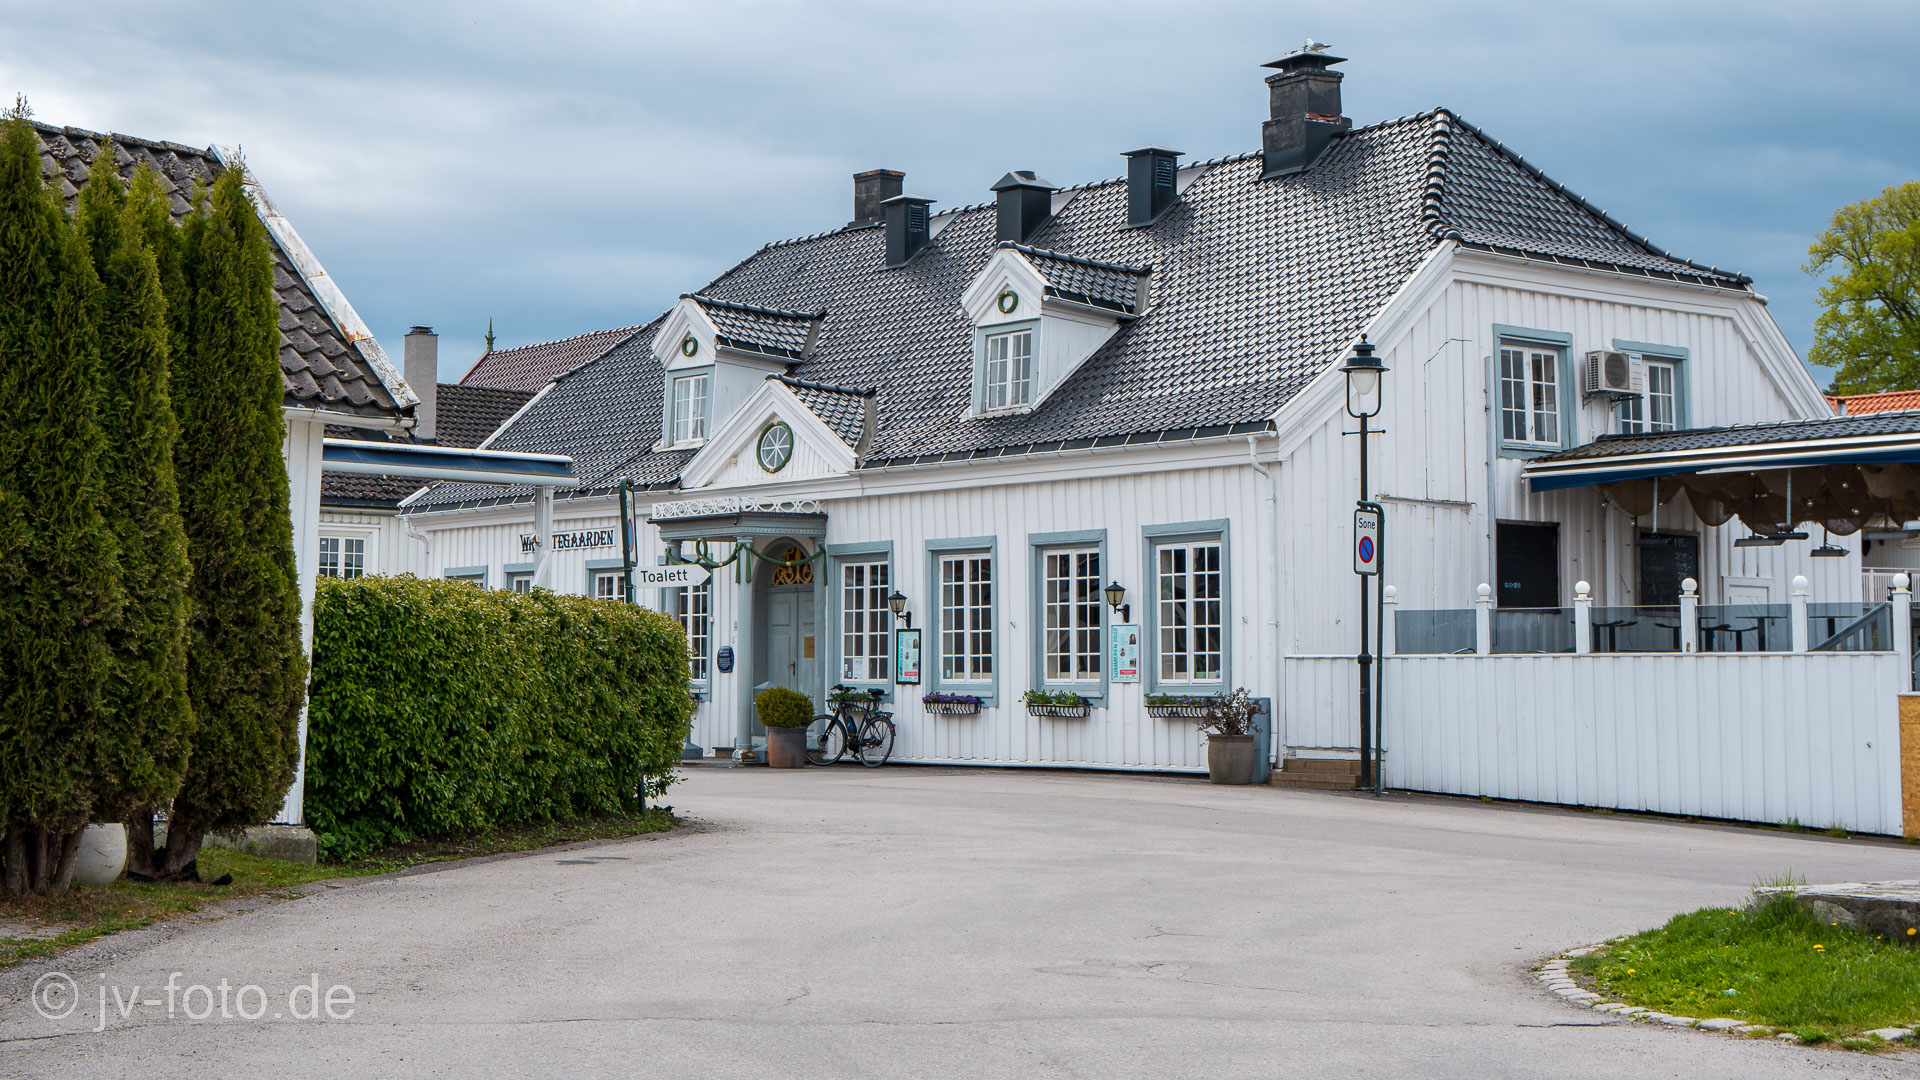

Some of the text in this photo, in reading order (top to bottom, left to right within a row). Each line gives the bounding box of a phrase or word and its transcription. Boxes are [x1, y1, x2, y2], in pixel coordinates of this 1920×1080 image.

[1358, 517, 1376, 530] Sone
[520, 530, 614, 552] WRTEGAARDEN
[640, 569, 688, 583] Toalett
